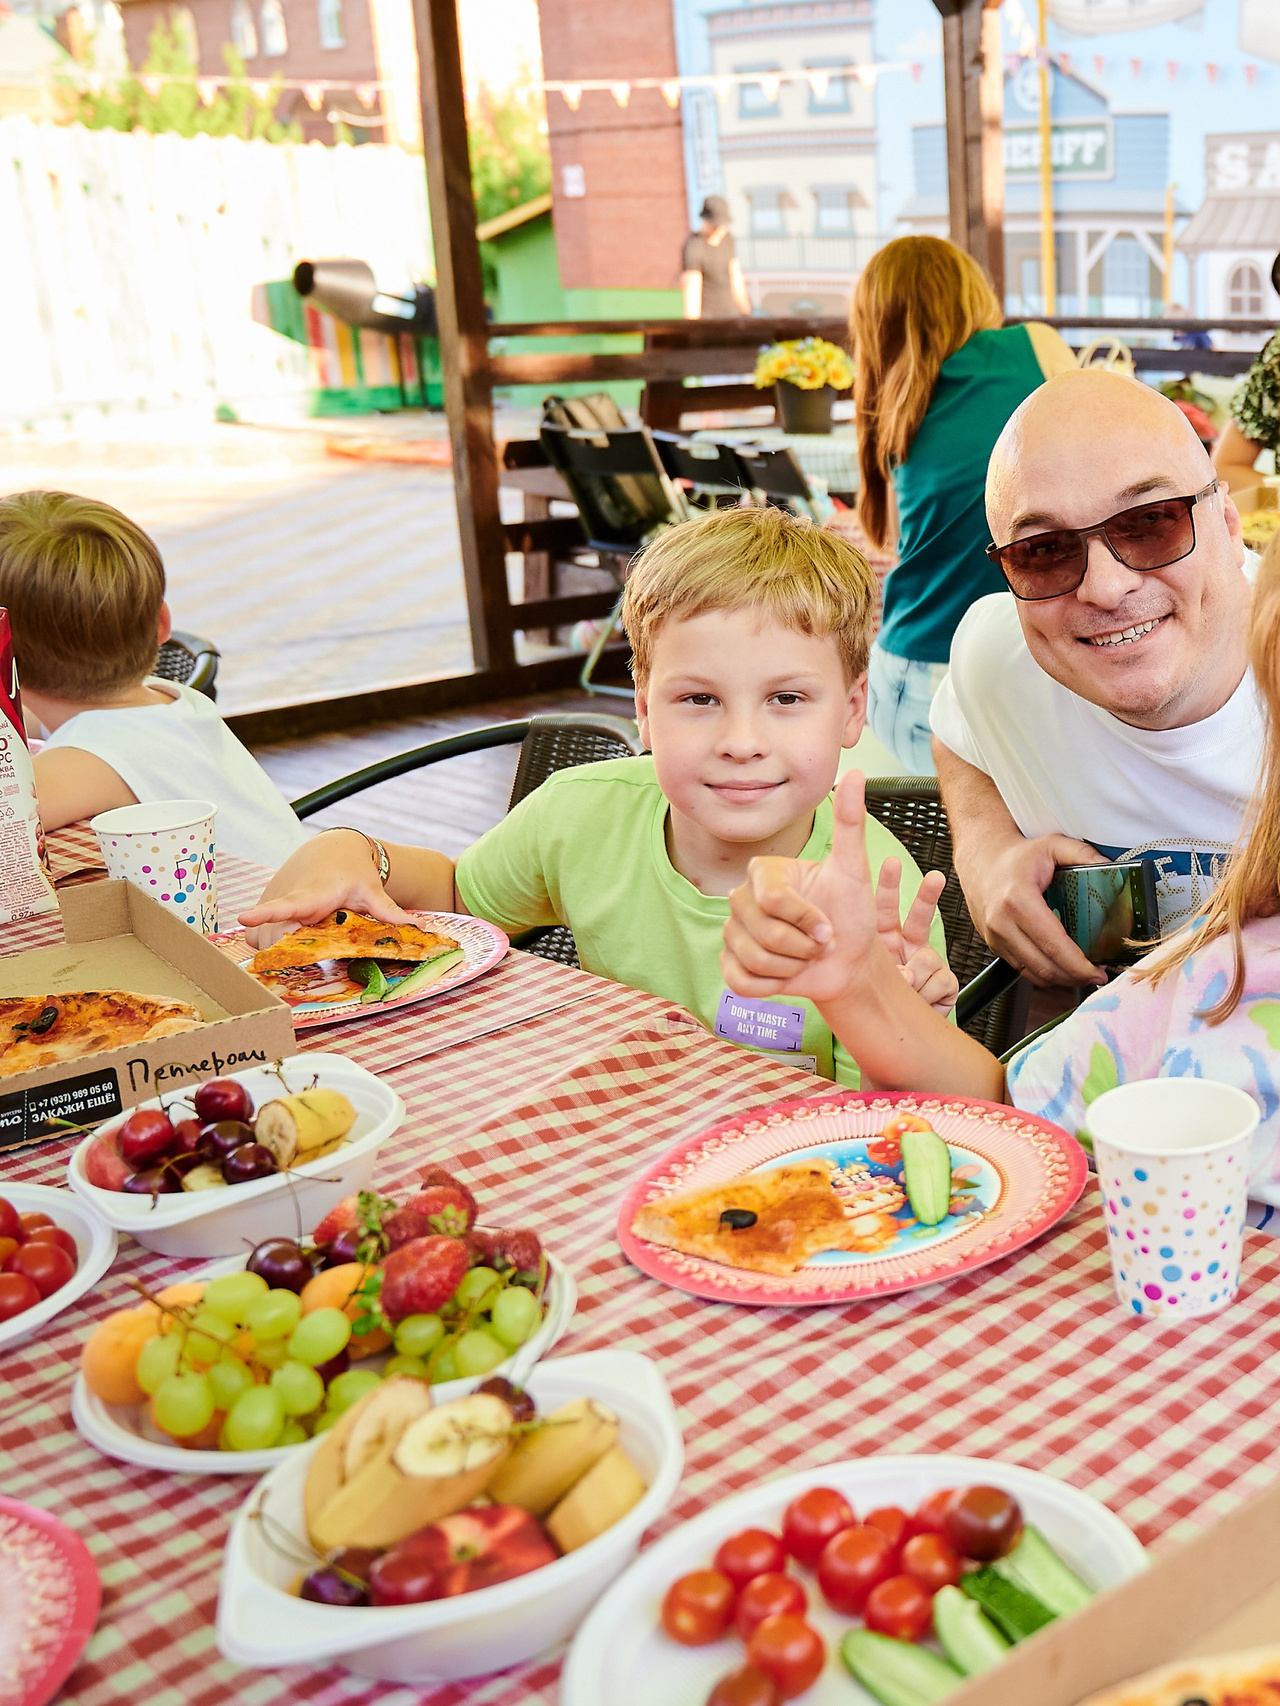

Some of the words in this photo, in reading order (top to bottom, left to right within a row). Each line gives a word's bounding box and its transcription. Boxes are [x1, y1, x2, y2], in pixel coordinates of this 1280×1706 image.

[1001, 130, 1106, 169] ERIFF
[730, 1004, 756, 1021] DON'T
[757, 1012, 788, 1028] WASTE
[736, 1022, 755, 1034] ANY
[757, 1026, 778, 1040] TIME
[38, 1098, 48, 1107] +7
[50, 1092, 71, 1106] (937)
[72, 1088, 88, 1099] 989
[89, 1086, 100, 1095] 05
[102, 1081, 113, 1091] 60
[31, 1101, 85, 1123] ЗАКАЖИ
